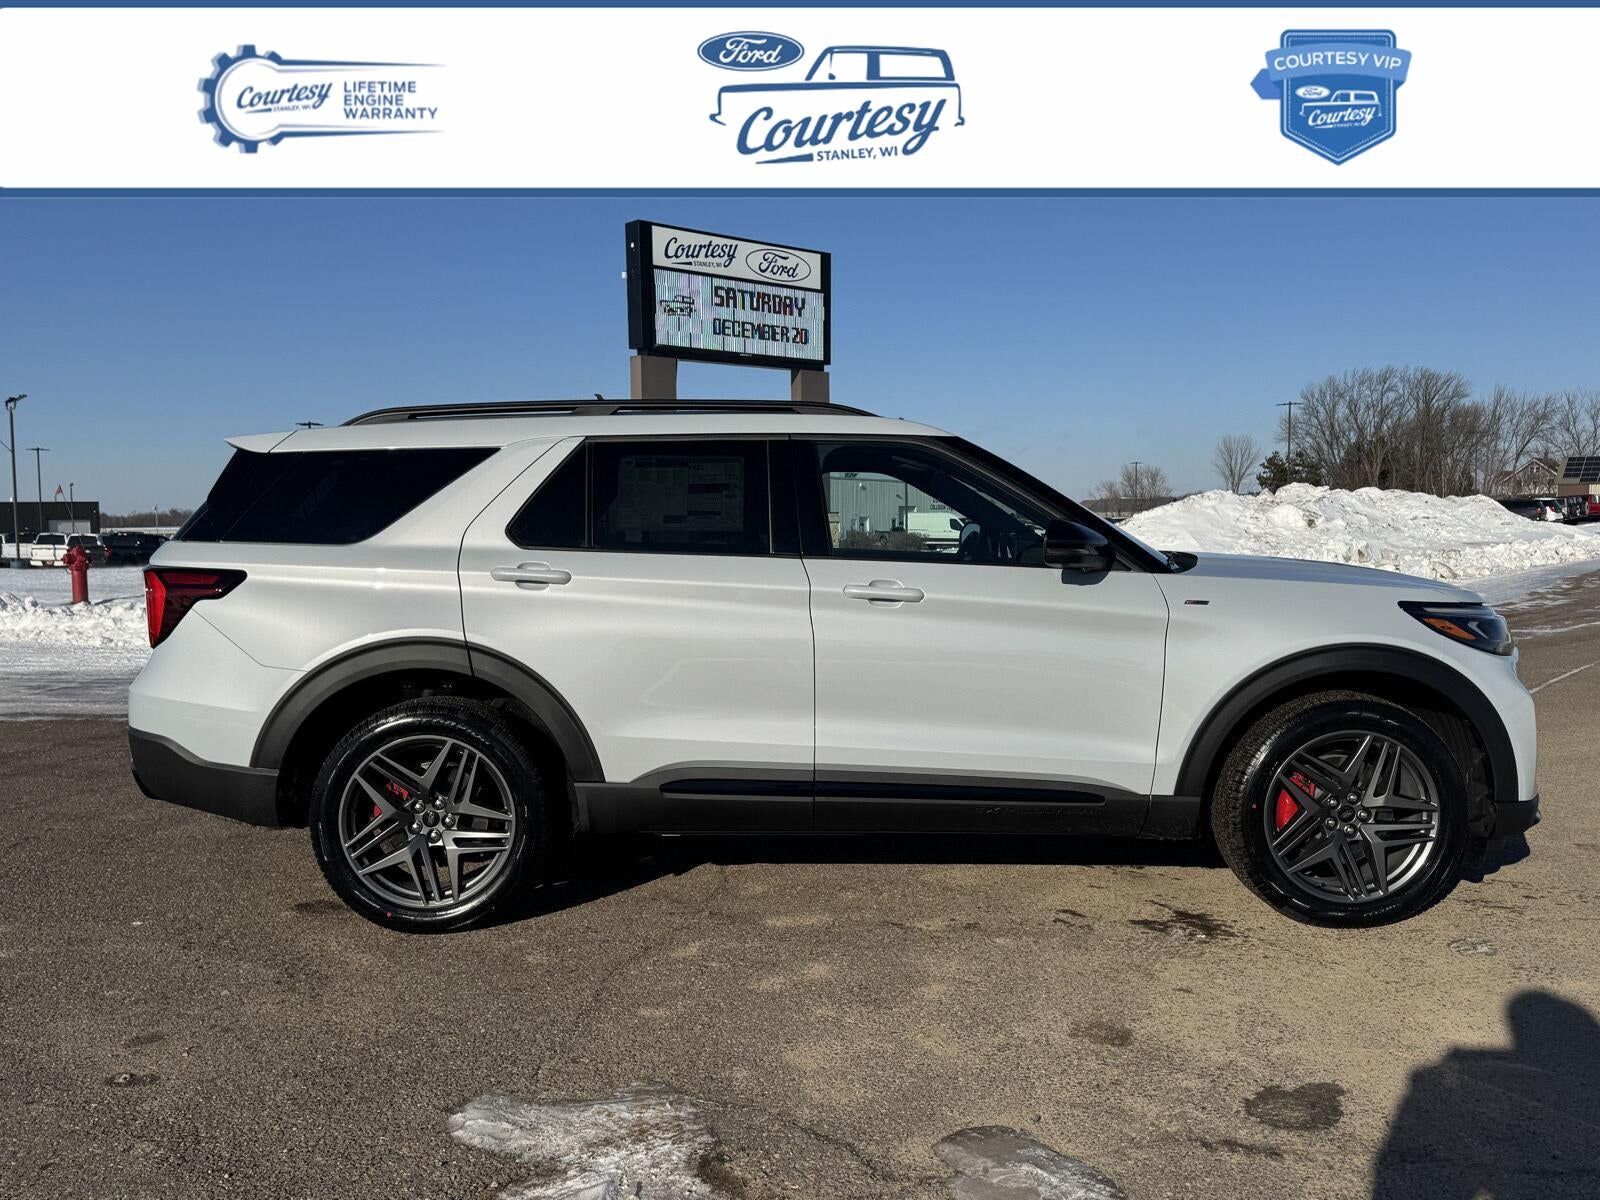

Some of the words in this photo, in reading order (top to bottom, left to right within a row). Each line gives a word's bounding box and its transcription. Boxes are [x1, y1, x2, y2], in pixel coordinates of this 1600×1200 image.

[664, 237, 738, 268] Courtesy
[758, 251, 799, 278] Ford
[713, 286, 805, 317] SATURDAY
[713, 318, 789, 343] DECEMBER
[791, 327, 809, 345] 20
